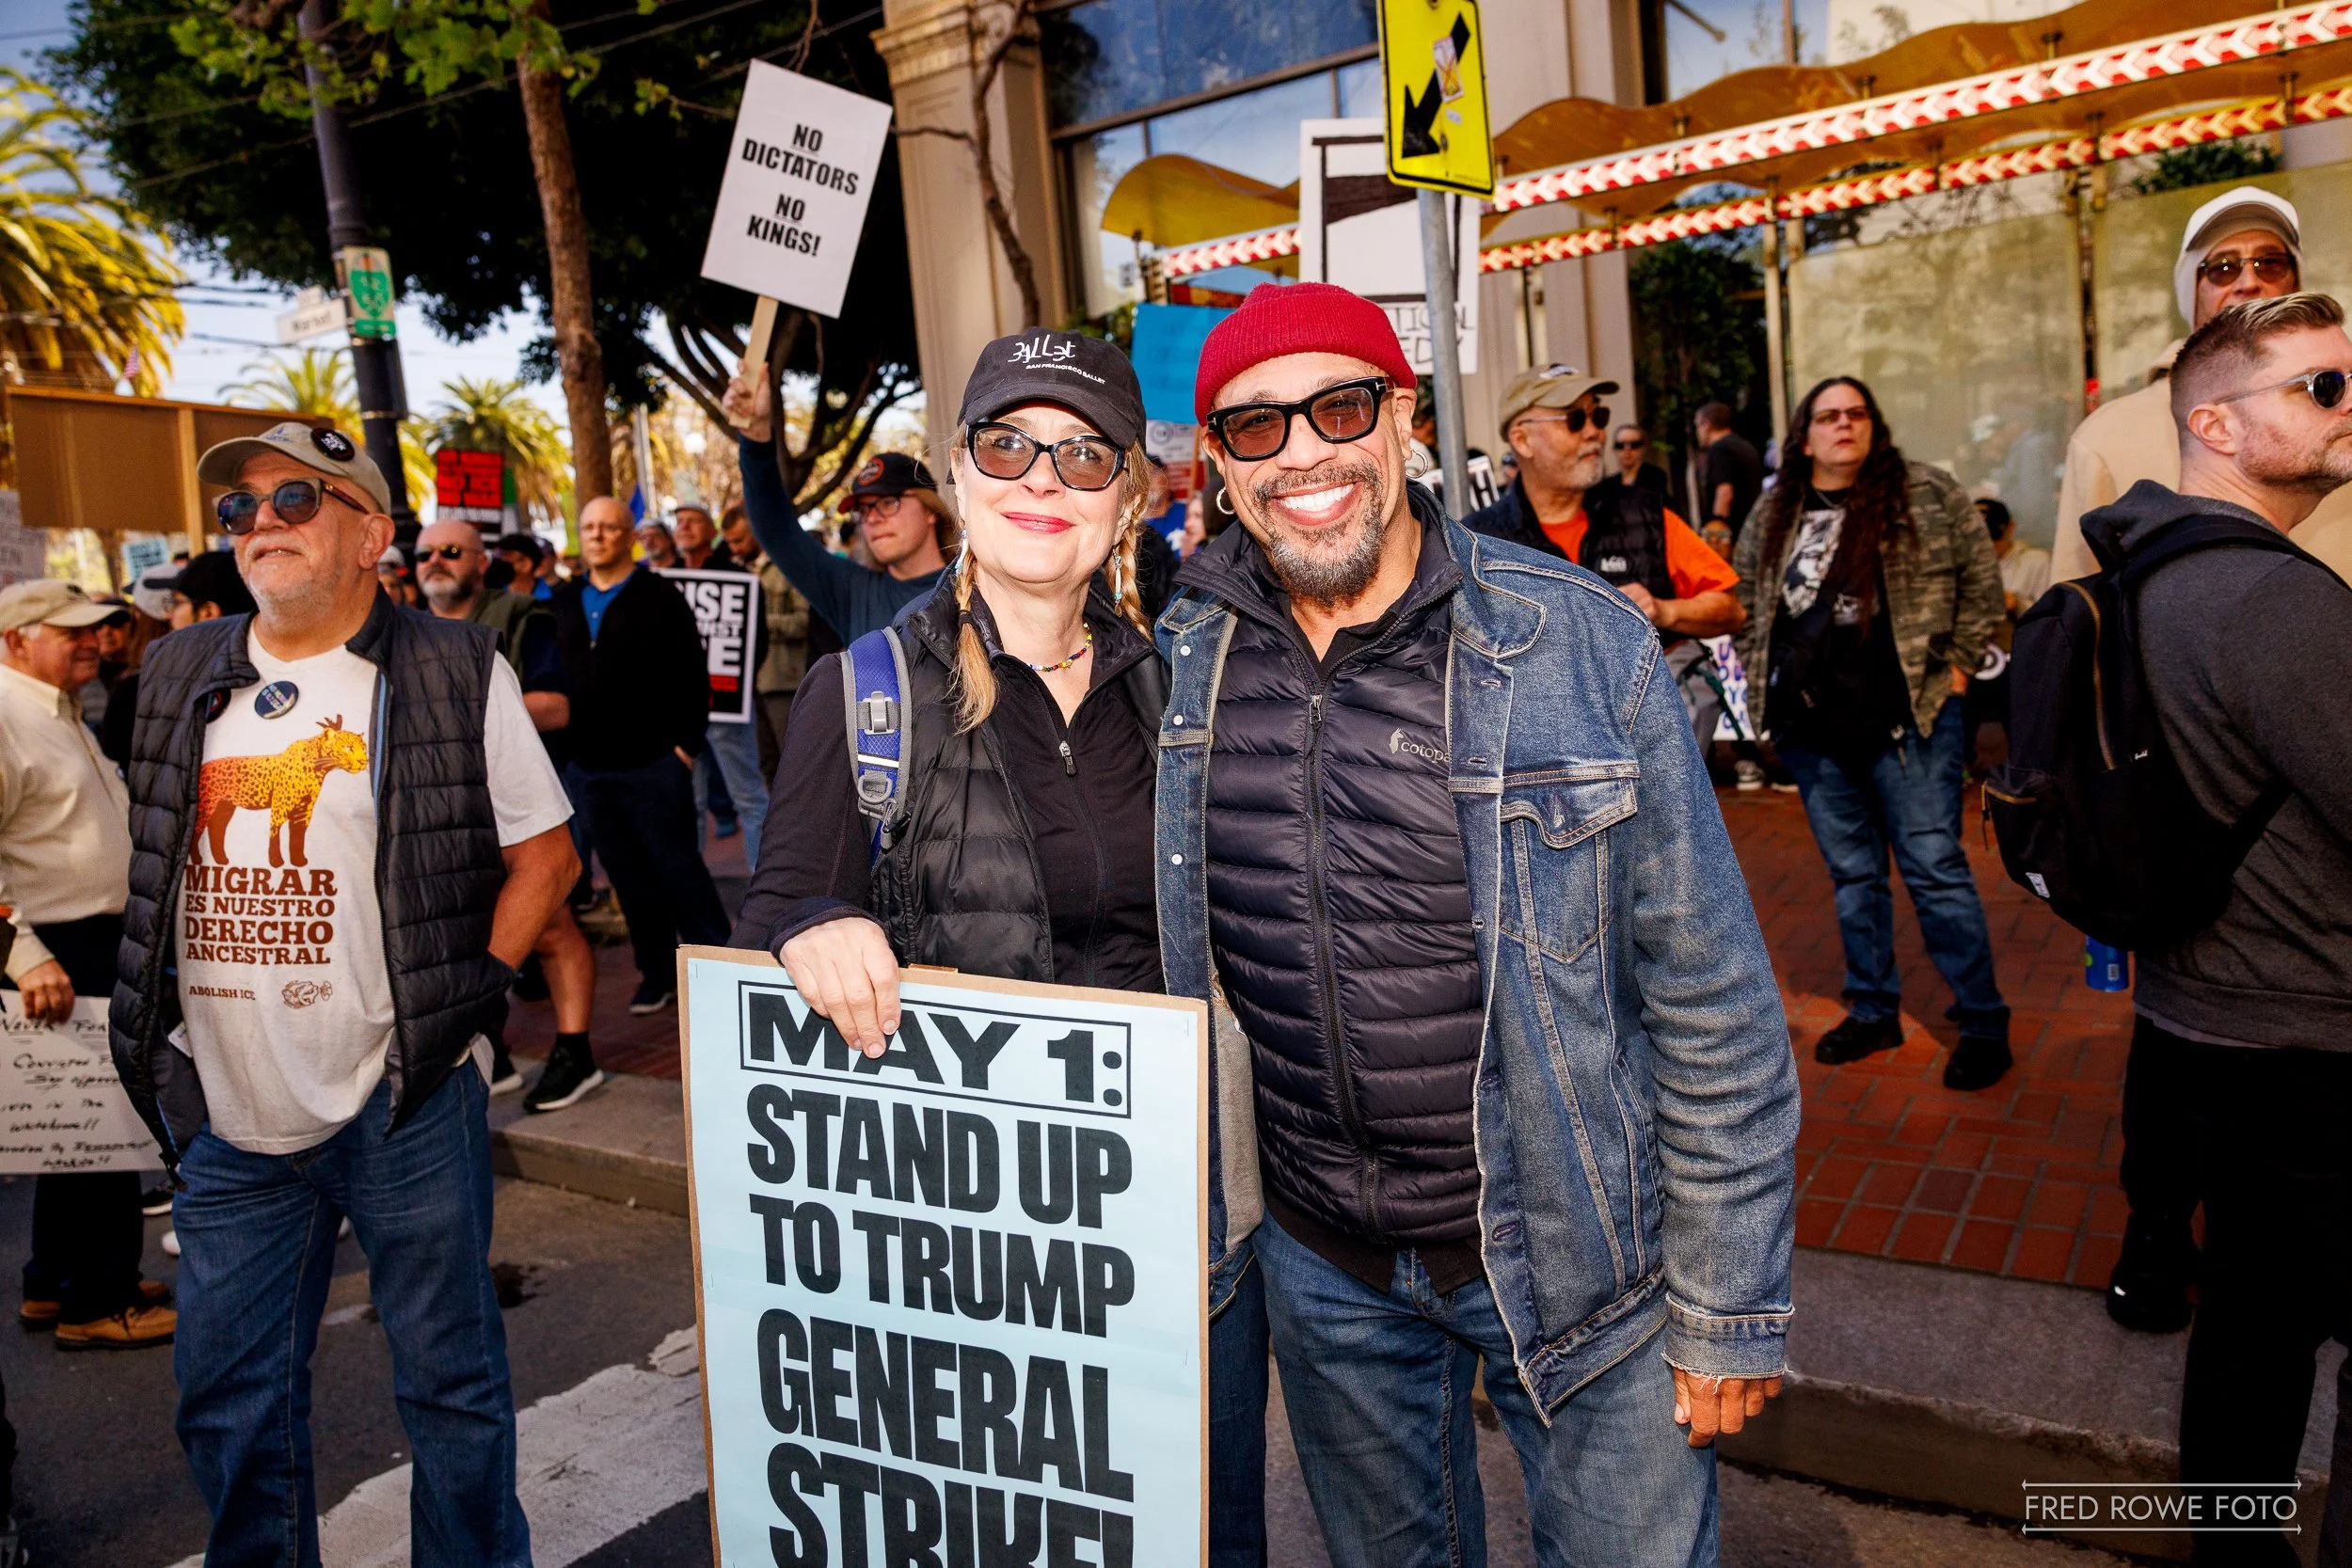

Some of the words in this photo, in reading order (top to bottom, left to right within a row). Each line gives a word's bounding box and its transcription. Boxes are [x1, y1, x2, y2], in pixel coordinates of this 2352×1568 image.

[792, 123, 823, 152] NO
[741, 137, 859, 196] DICTATORS
[775, 193, 806, 222] NO
[746, 214, 821, 257] KINGS!
[1041, 363, 1083, 376] FRANCISCO
[1082, 371, 1106, 385] BALLET
[184, 864, 338, 896] MIGRAR
[184, 894, 207, 913] ES
[213, 896, 335, 918] NUESTRO
[184, 915, 334, 945] DERECHO
[185, 942, 331, 965] ANCESTRAL
[188, 985, 237, 1000] ABOLISH
[240, 989, 257, 1001] ICE
[748, 991, 1022, 1090] MAY
[1047, 1029, 1123, 1108] 1:
[747, 1084, 1001, 1213] STAND
[1017, 1119, 1134, 1229] UP
[749, 1193, 841, 1294] TO
[852, 1210, 1136, 1338] TRUMP
[756, 1308, 1135, 1503] GENERAL
